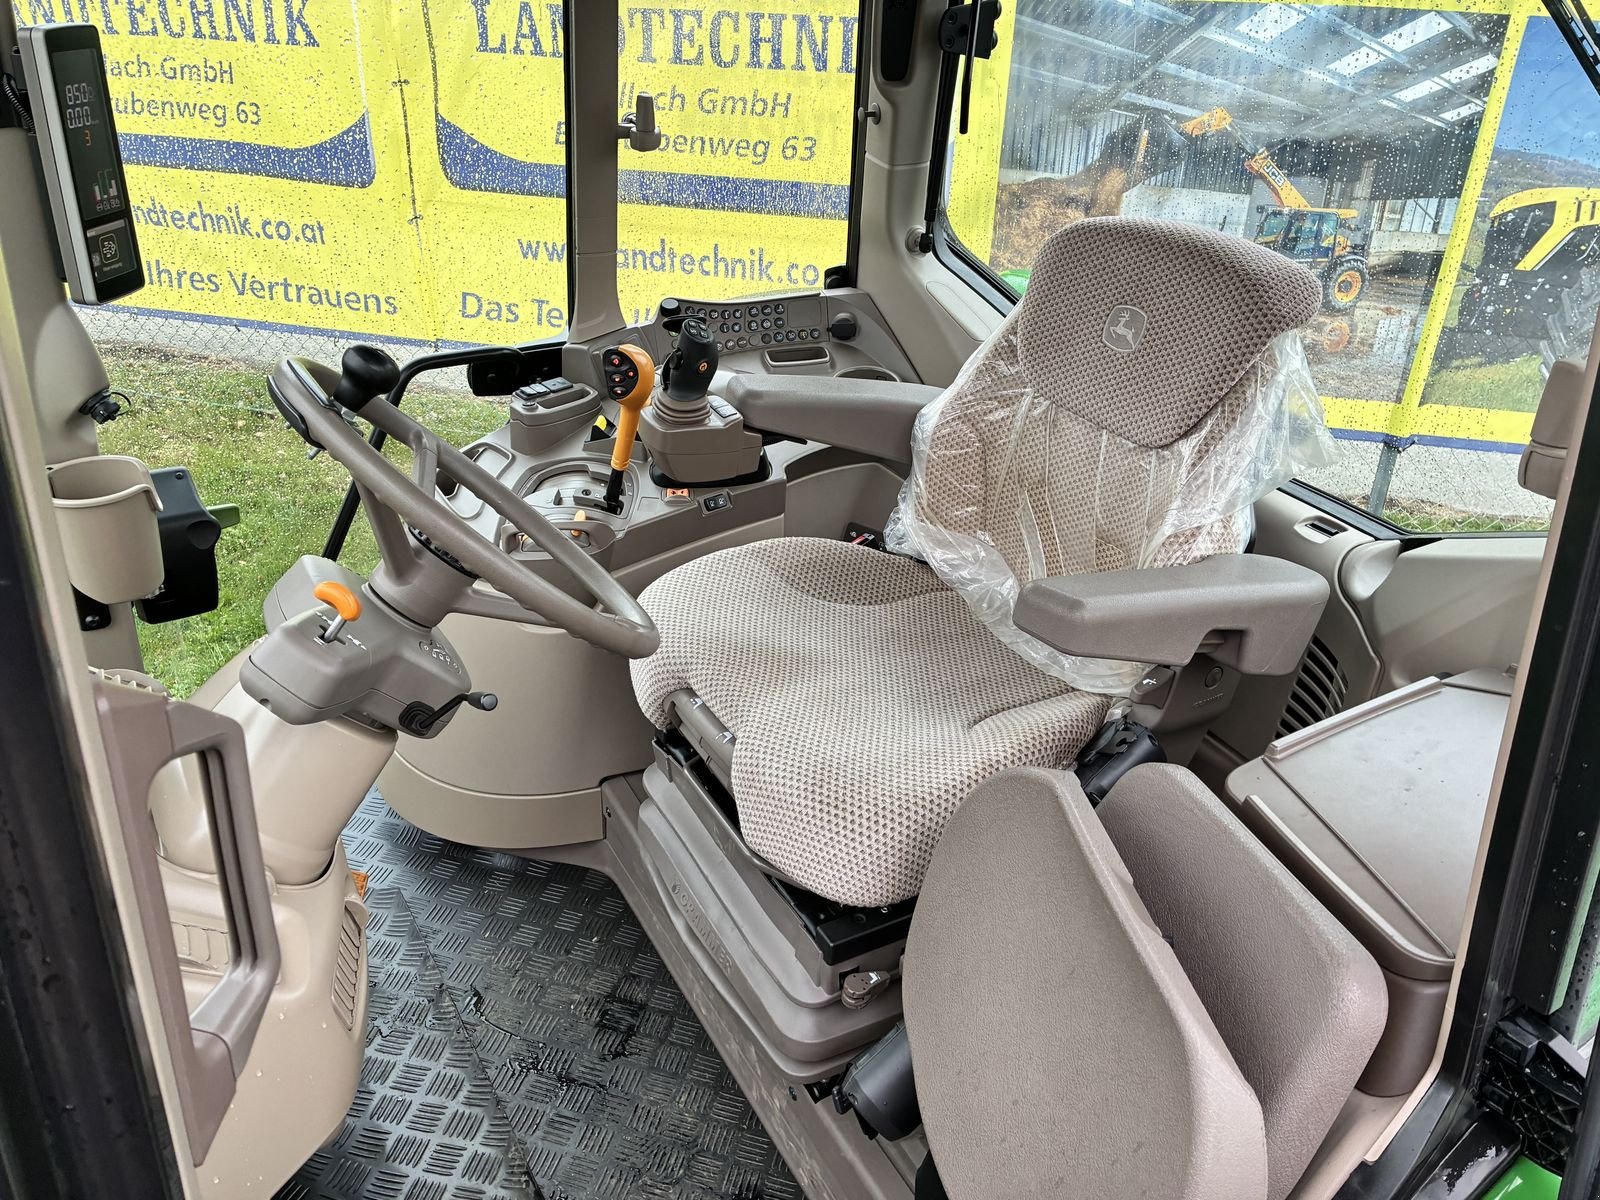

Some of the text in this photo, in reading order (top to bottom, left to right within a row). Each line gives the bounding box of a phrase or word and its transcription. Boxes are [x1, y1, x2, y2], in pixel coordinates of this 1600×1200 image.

[160, 55, 234, 84] GmbH
[235, 101, 262, 125] 63
[698, 88, 792, 119] GmbH
[83, 129, 92, 147] 3
[781, 136, 817, 162] 63
[1263, 161, 1286, 187] JCB
[146, 259, 399, 315] Ihres Vertrauens
[461, 291, 519, 323] Das
